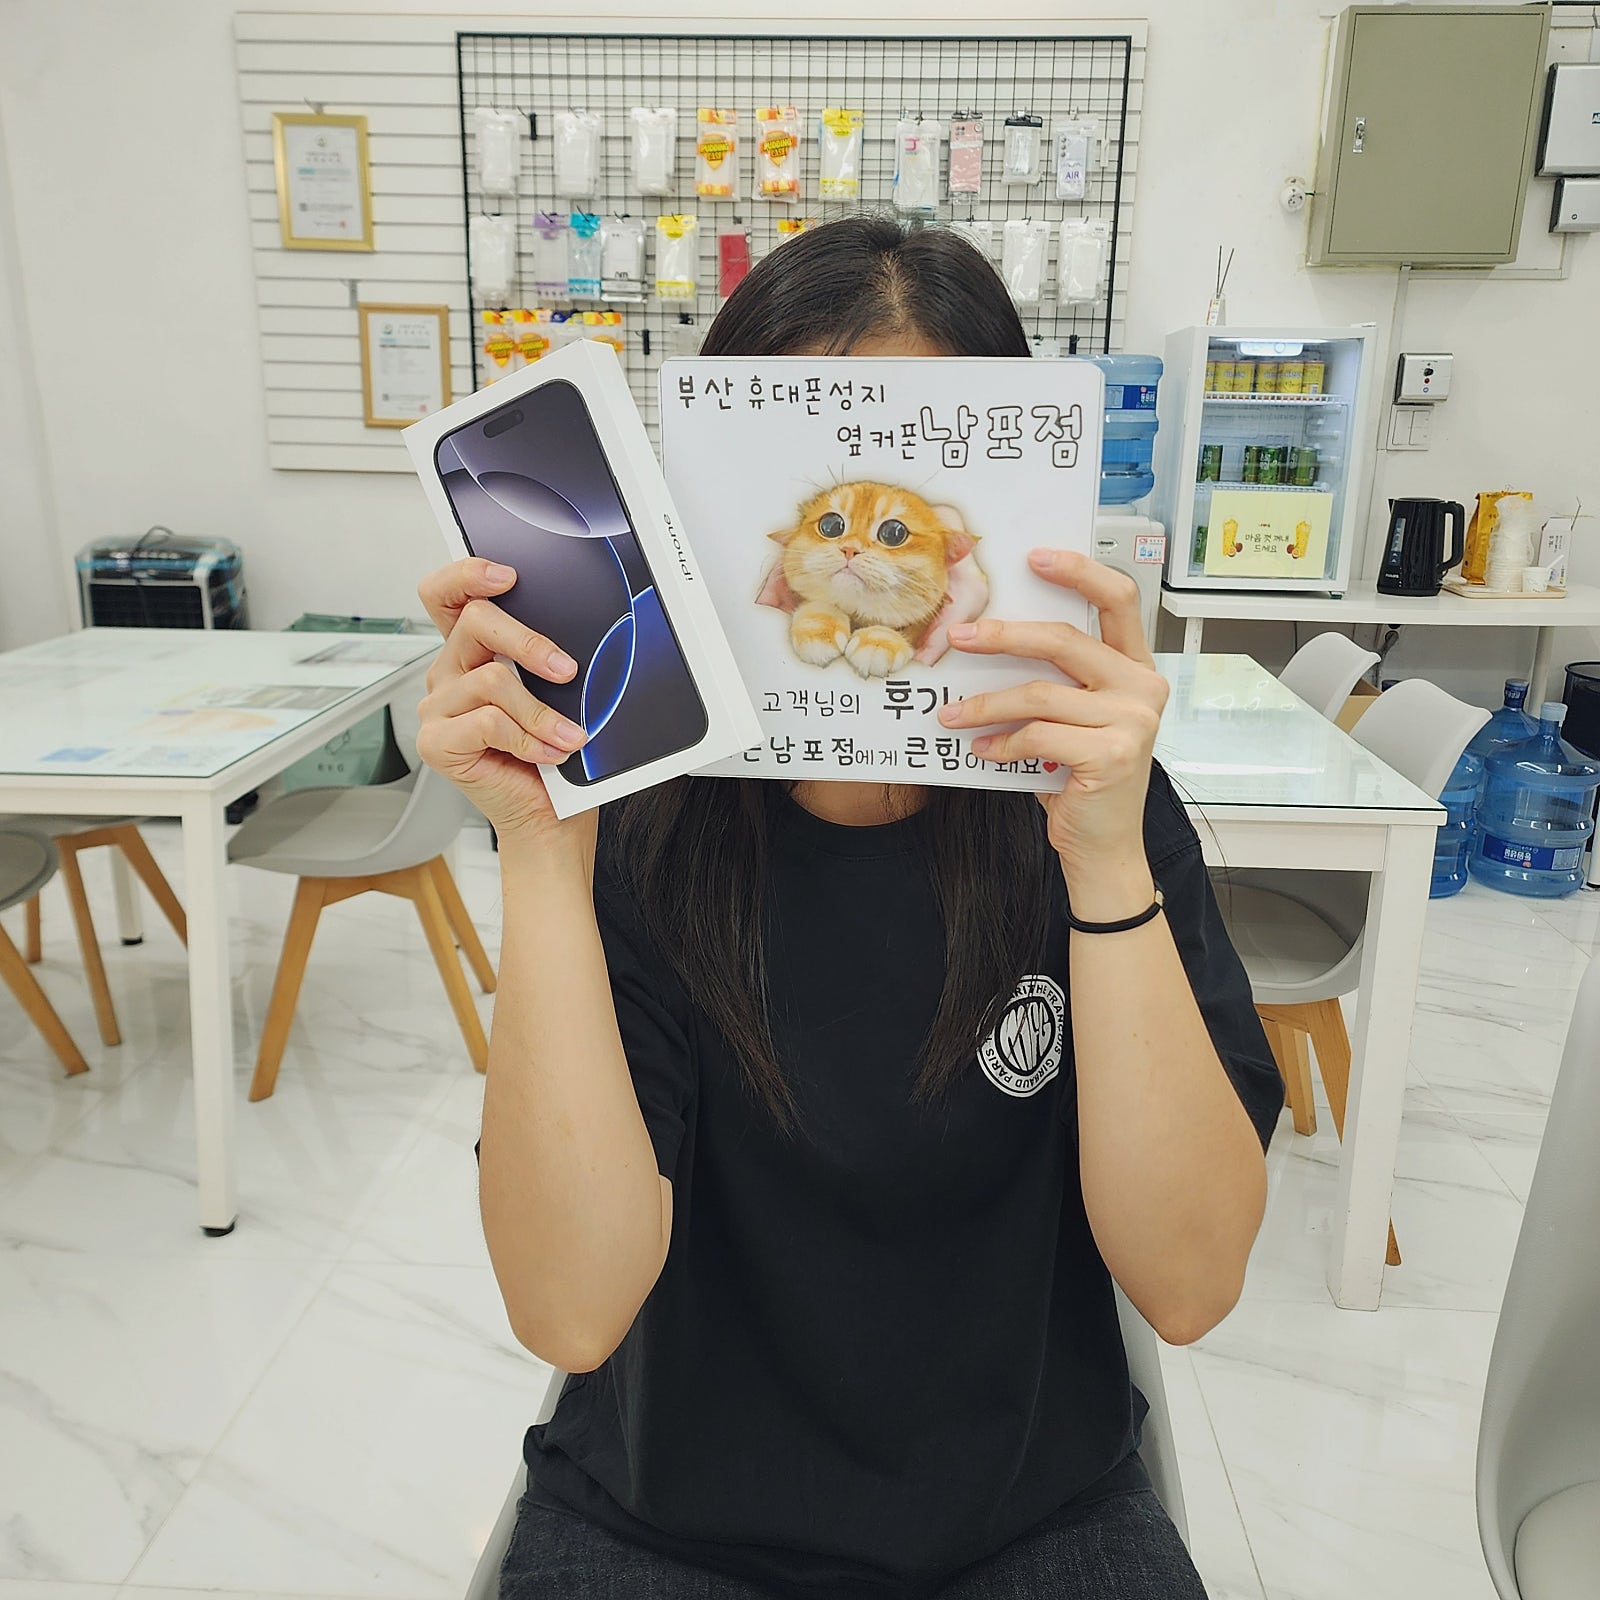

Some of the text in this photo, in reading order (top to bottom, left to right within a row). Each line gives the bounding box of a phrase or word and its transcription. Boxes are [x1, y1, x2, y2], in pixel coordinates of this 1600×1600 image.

[1065, 170, 1080, 180] AIR
[679, 375, 885, 415] 부산 휴대폰성지
[837, 404, 1082, 468] 옆커폰 남포점
[663, 513, 693, 581] iPhone
[1253, 544, 1277, 553] 드세요
[762, 680, 963, 720] 고객님의 후기
[985, 1048, 1013, 1083] PARIS
[1015, 1058, 1054, 1089] GIRBAUD
